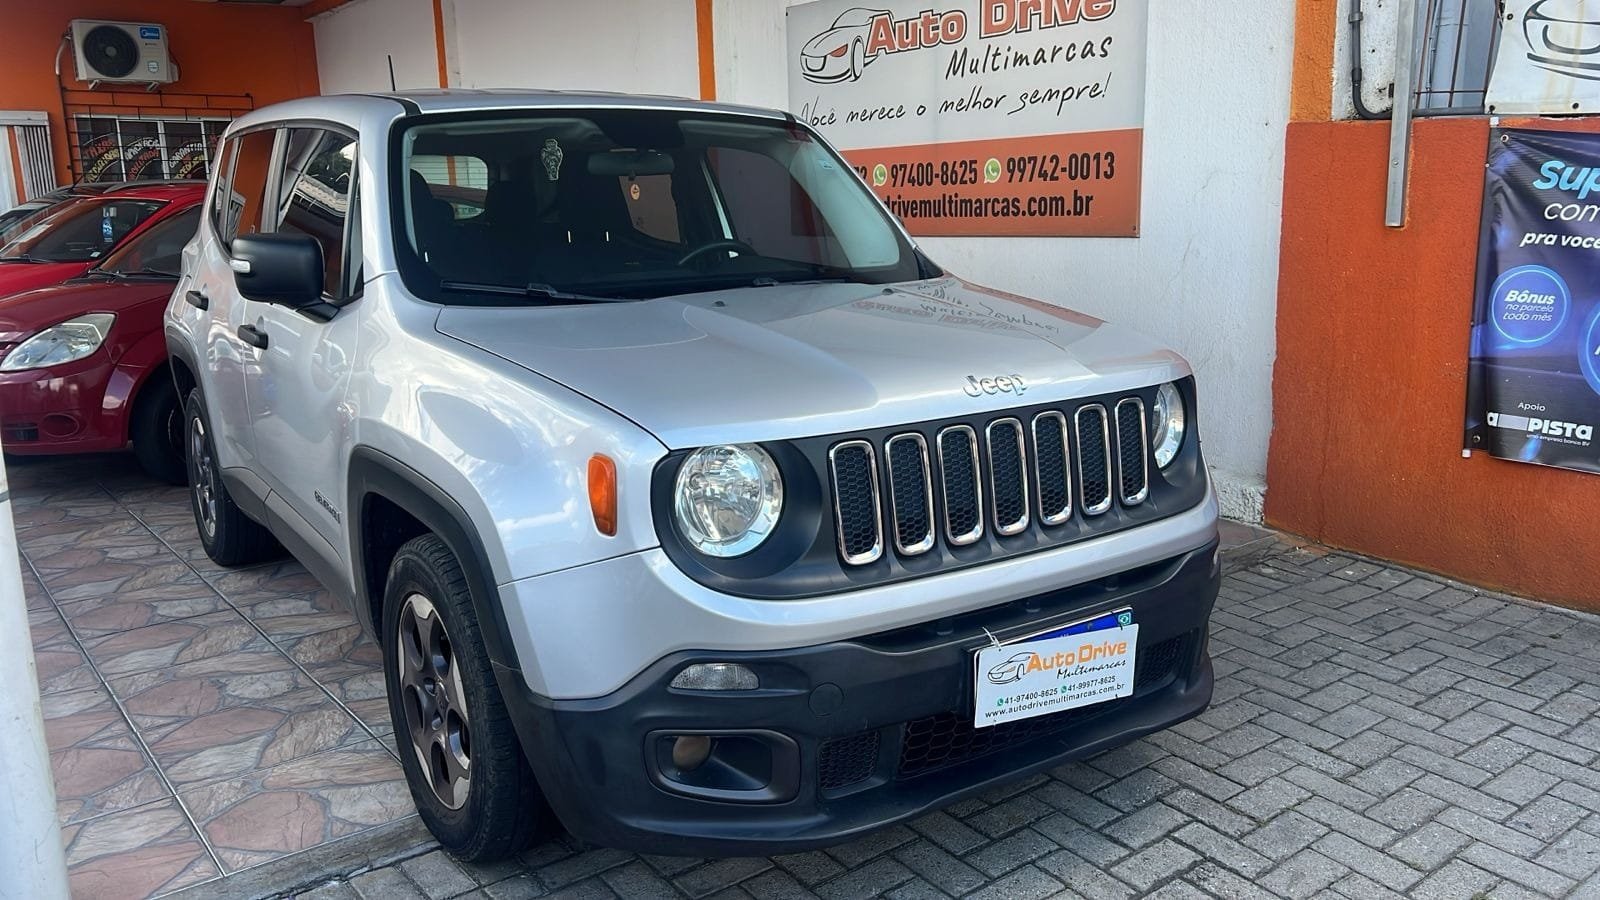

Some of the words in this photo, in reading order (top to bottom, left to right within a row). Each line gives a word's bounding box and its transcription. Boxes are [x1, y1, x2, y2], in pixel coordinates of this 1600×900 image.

[866, 10, 968, 56] Auto
[979, 0, 1116, 39] Drive
[945, 36, 1113, 80] Multimarcas
[802, 96, 836, 126] Você
[846, 104, 905, 124] merece
[916, 105, 928, 116] o
[939, 86, 1007, 114] melhor
[1008, 72, 1112, 116] sempre!
[891, 160, 978, 187] 97400-8625
[1006, 152, 1116, 183] 99742-0013
[1520, 232, 1558, 247] pra
[1504, 289, 1556, 304] Bônus
[1503, 311, 1530, 320] todo
[962, 372, 1027, 398] Jeep
[1518, 402, 1546, 412] Apoio
[1026, 651, 1076, 673] Auto
[1078, 641, 1128, 663] Drive
[1056, 660, 1127, 680] Multimarcas
[985, 682, 1126, 718] www.autodrivemultimarcas.com.br
[1004, 688, 1058, 705] 41-97400-8625
